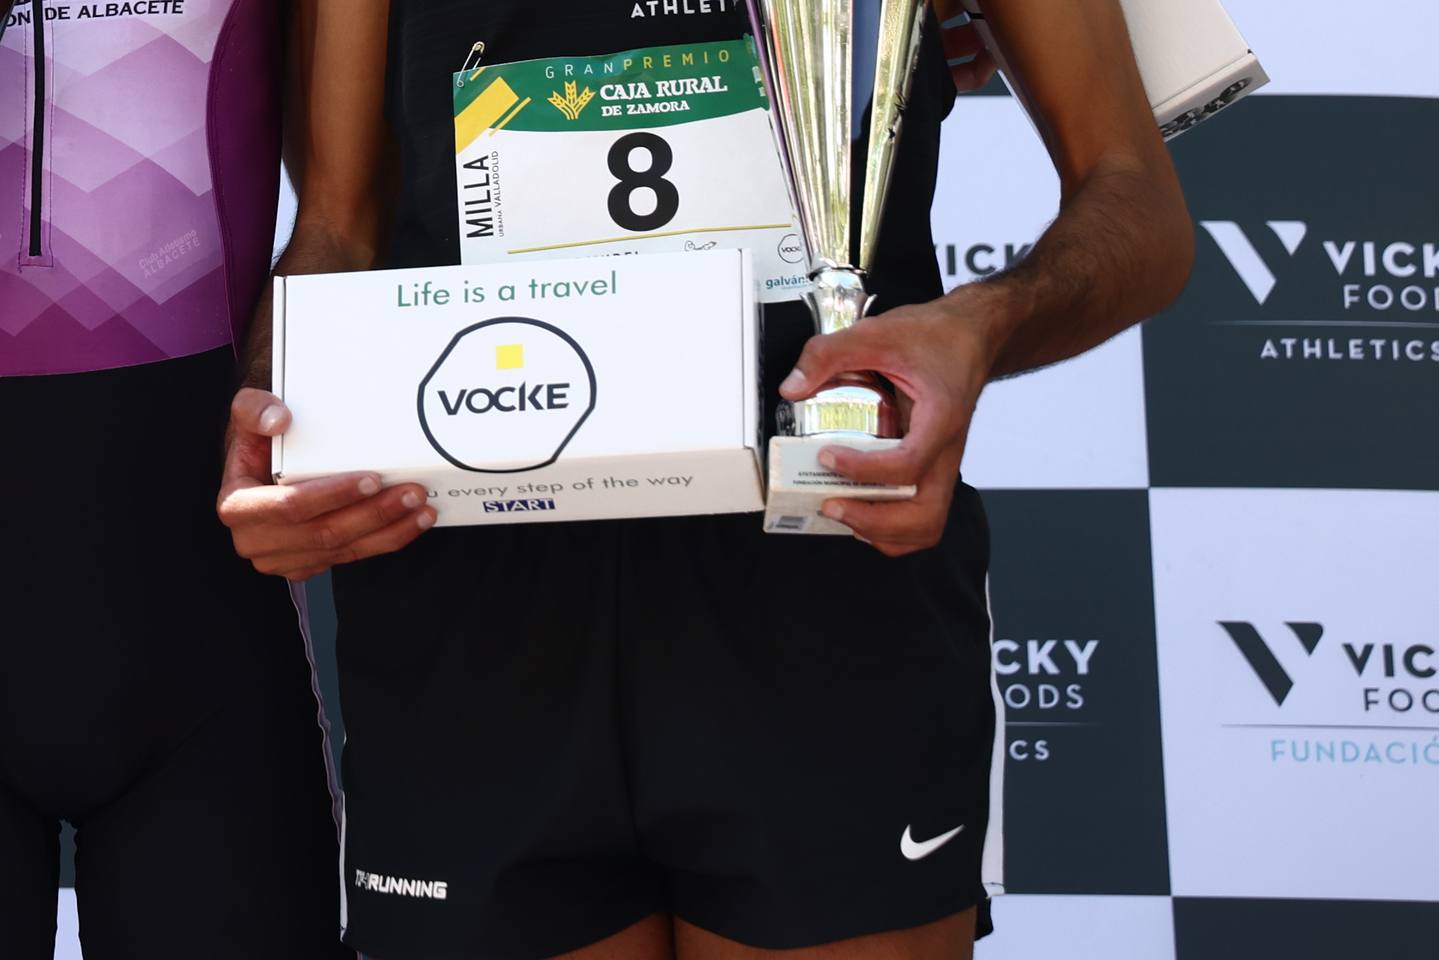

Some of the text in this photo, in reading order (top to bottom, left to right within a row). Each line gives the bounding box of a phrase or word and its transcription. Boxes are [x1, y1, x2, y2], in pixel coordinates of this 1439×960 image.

[44, 6, 71, 21] DE
[77, 0, 185, 20] ALBACETE
[599, 76, 729, 102] CAJA RURAL
[601, 100, 691, 117] DE ZAMORA
[491, 150, 503, 208] VALLADOLID
[607, 132, 679, 232] 8
[463, 154, 495, 238] MILLA
[397, 270, 617, 308] Life is a travel
[437, 380, 571, 416] VOCKE
[447, 485, 508, 499] every
[517, 481, 564, 496] step
[572, 476, 594, 490] of
[603, 476, 639, 489] the
[647, 474, 694, 488] way
[483, 498, 556, 513] START
[991, 639, 1100, 675] CKY
[1342, 643, 1438, 679] VIC
[1004, 683, 1085, 710] ODS
[1363, 687, 1439, 713] FOO
[1270, 735, 1439, 766] FUNDACIÓ
